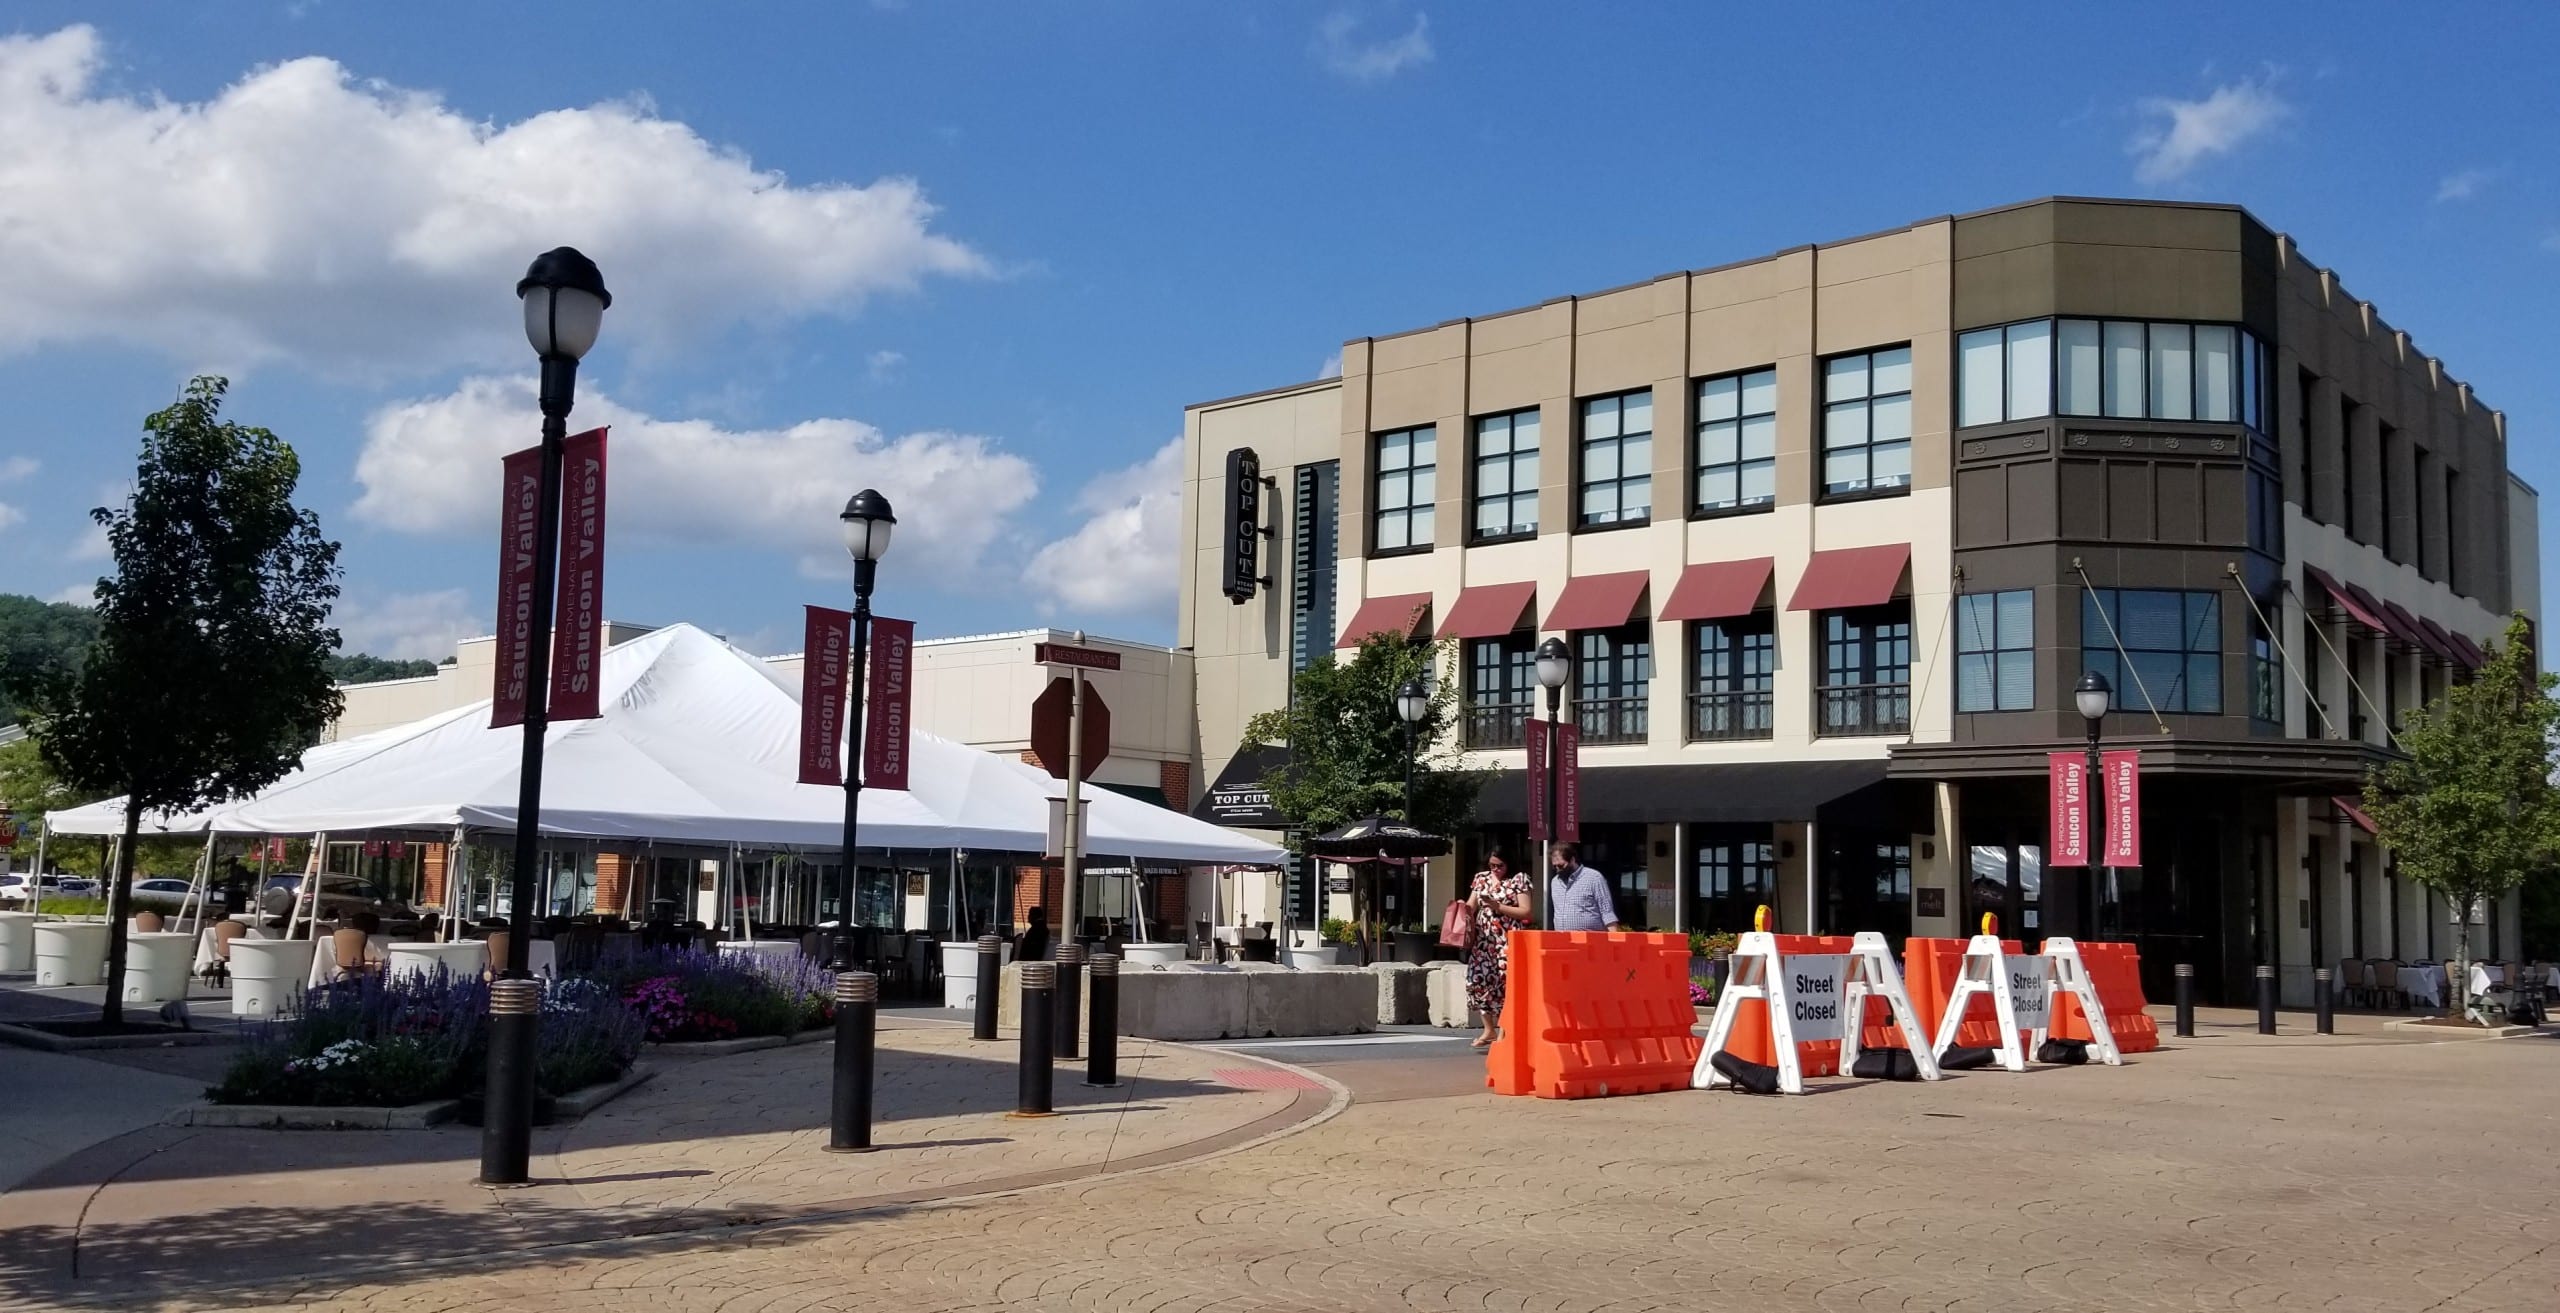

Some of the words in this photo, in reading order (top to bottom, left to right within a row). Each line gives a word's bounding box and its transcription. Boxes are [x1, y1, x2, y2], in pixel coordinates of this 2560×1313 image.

[572, 465, 580, 483] AT
[1241, 460, 1255, 511] TOP
[515, 475, 537, 573] Valley
[569, 487, 579, 545] SHOPS
[580, 458, 599, 560] Valley
[1239, 520, 1254, 574] CUT
[563, 550, 577, 657] PROMENADE
[508, 582, 531, 700] Saucon
[571, 569, 593, 693] Saucon
[821, 625, 843, 687] Valley
[561, 663, 569, 694] THE
[887, 634, 906, 695] Valley
[818, 695, 836, 770] Saucon
[874, 686, 884, 751] PROMENADE
[884, 703, 901, 775] Saucon
[873, 753, 881, 773] THE
[1536, 730, 1544, 772] Valley
[1565, 734, 1575, 776] Valley
[1215, 795, 1240, 804] TOP
[1244, 794, 1270, 803] CUT
[1566, 781, 1574, 832] Saucon
[2066, 762, 2081, 803] Valley
[2119, 761, 2132, 803] Valley
[2066, 807, 2079, 856] Saucon
[2120, 806, 2131, 856] Saucon
[1796, 974, 1834, 994] Street
[2012, 996, 2043, 1013] Closed
[2013, 972, 2041, 990] Street
[1795, 1000, 1836, 1021] Closed
